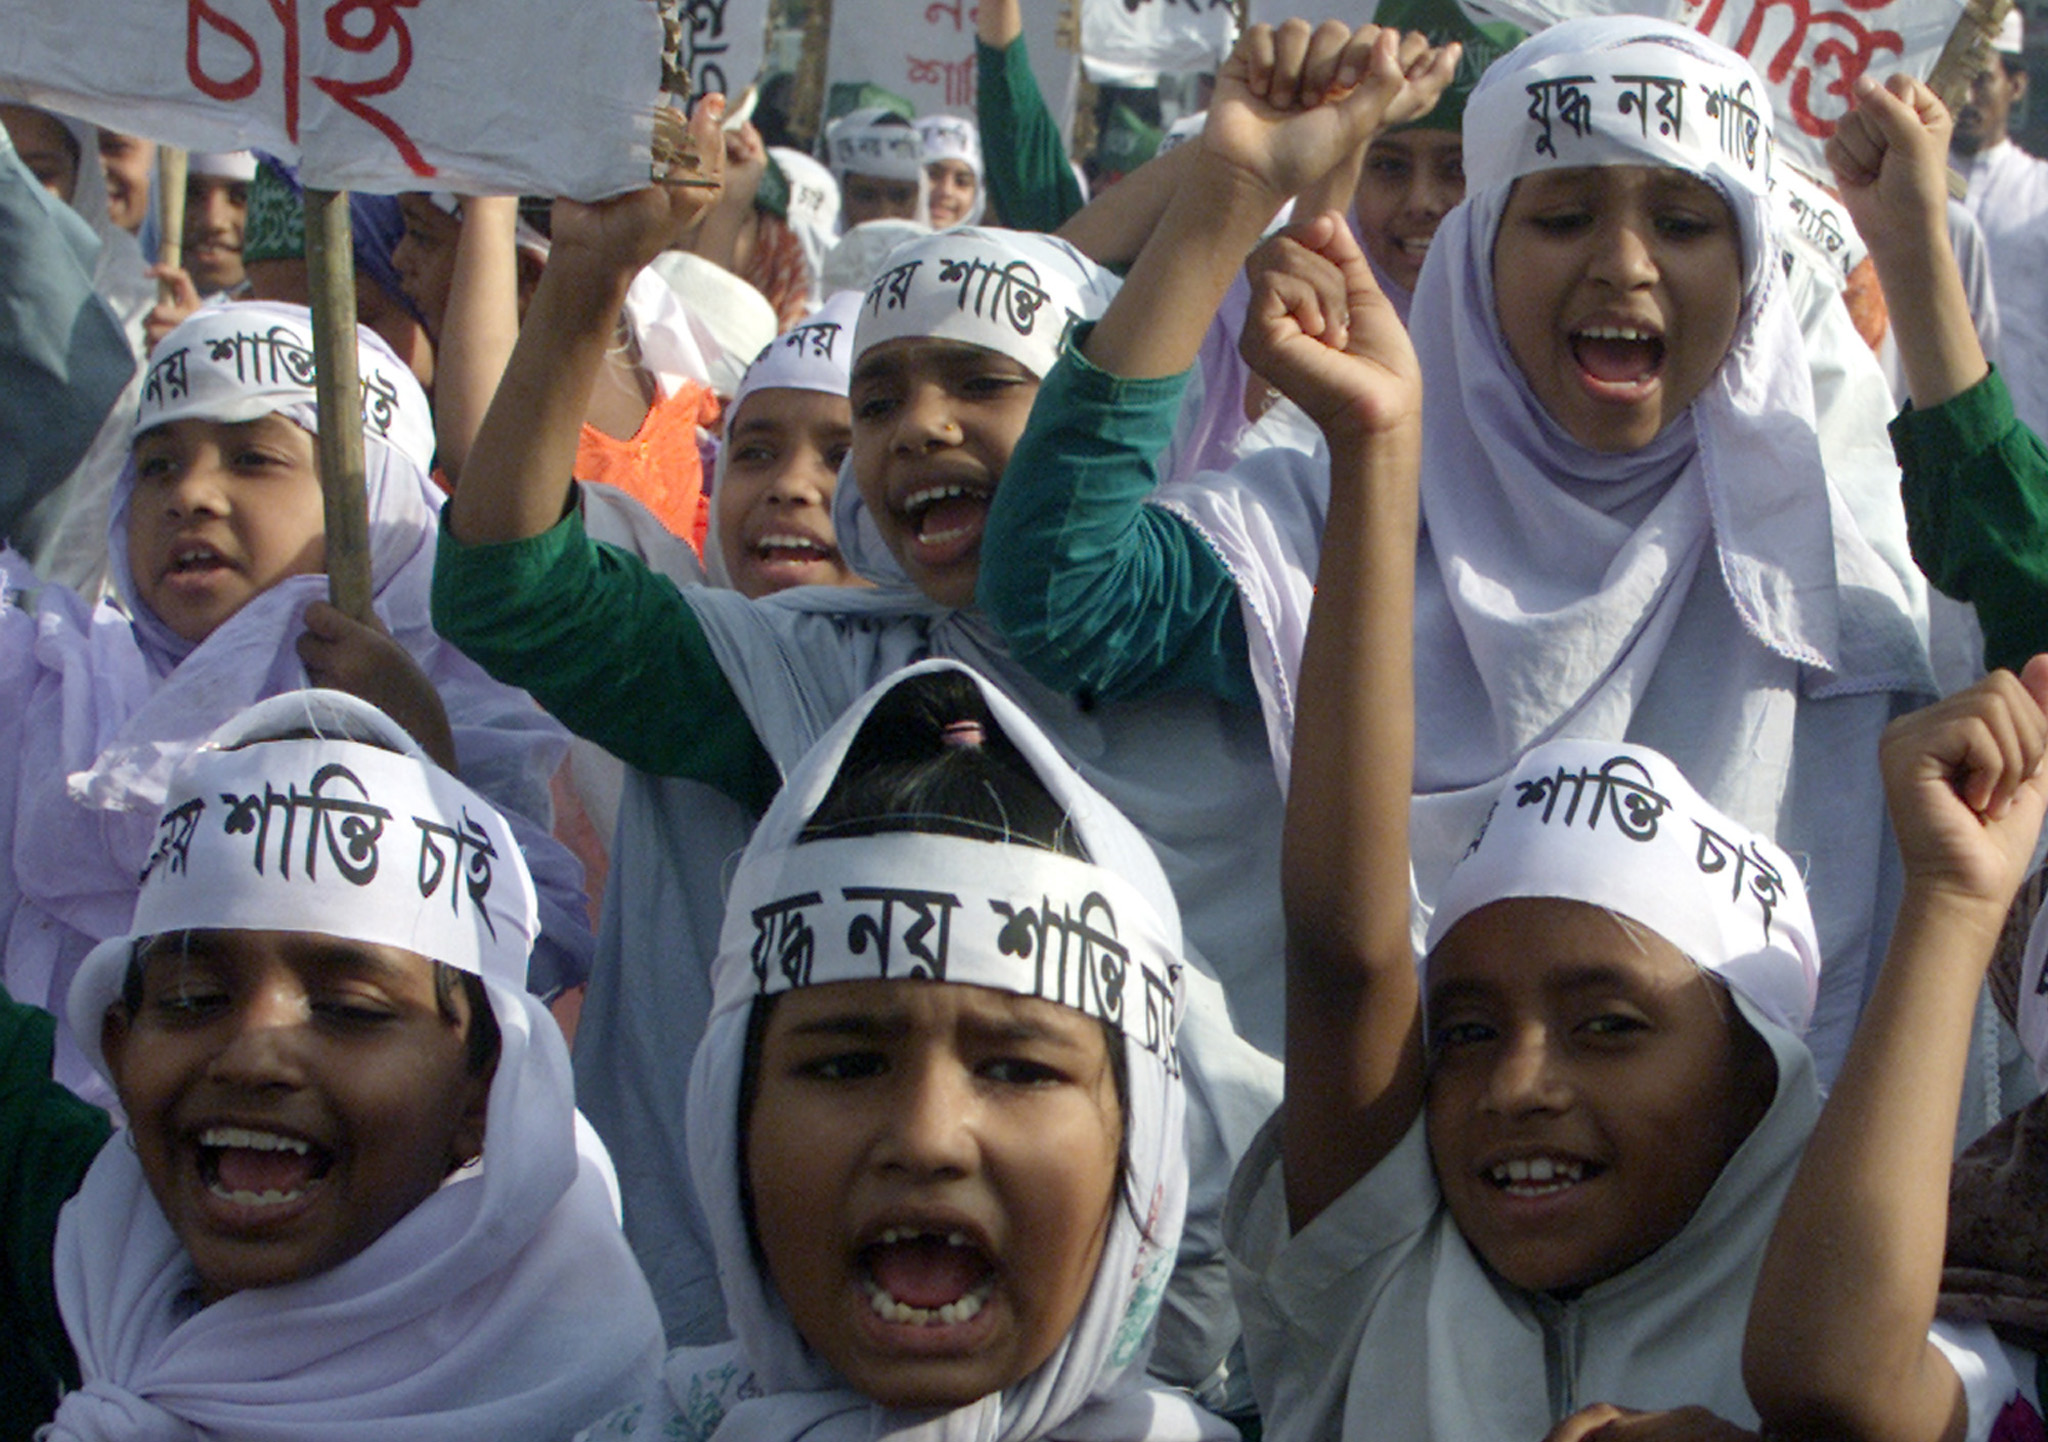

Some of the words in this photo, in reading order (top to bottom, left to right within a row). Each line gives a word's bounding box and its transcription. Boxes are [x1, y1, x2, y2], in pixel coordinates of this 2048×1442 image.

[1526, 75, 1597, 159] যুদ্ধ
[1611, 75, 1687, 142] নয়
[1700, 80, 1760, 171] শান্তি
[786, 322, 842, 361] নয়
[867, 259, 923, 318] নয়
[939, 257, 1051, 336] শান্তি
[220, 762, 393, 887] শান্তি
[411, 804, 498, 942] চাই
[1514, 755, 1673, 842] শান্তি
[1690, 818, 1787, 948] চাই
[841, 886, 962, 981] নয়
[988, 891, 1130, 1030] শান্তি
